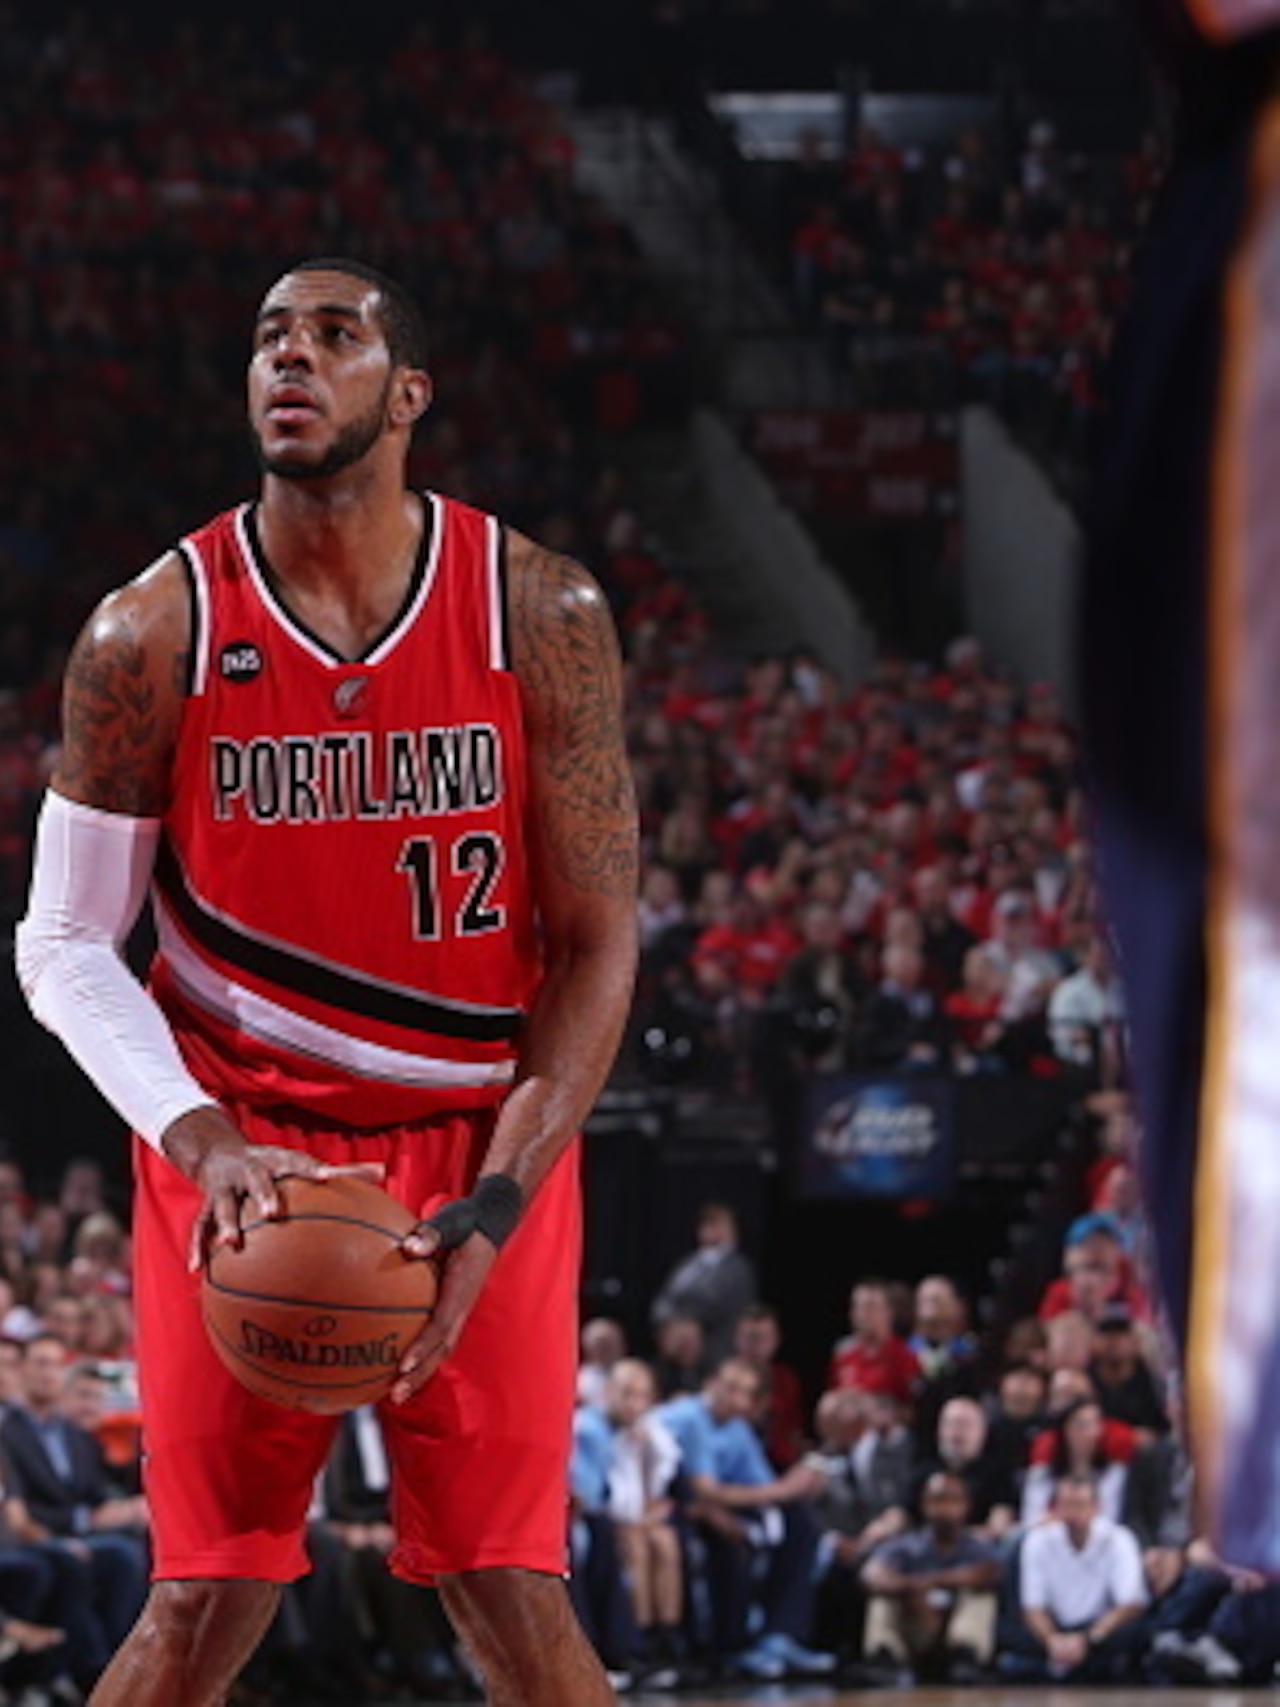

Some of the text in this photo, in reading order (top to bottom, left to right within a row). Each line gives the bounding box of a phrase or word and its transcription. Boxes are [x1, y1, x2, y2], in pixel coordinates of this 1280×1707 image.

[210, 723, 502, 824] PORTLAND
[394, 831, 507, 941] 12
[241, 1319, 400, 1367] SPALDING
